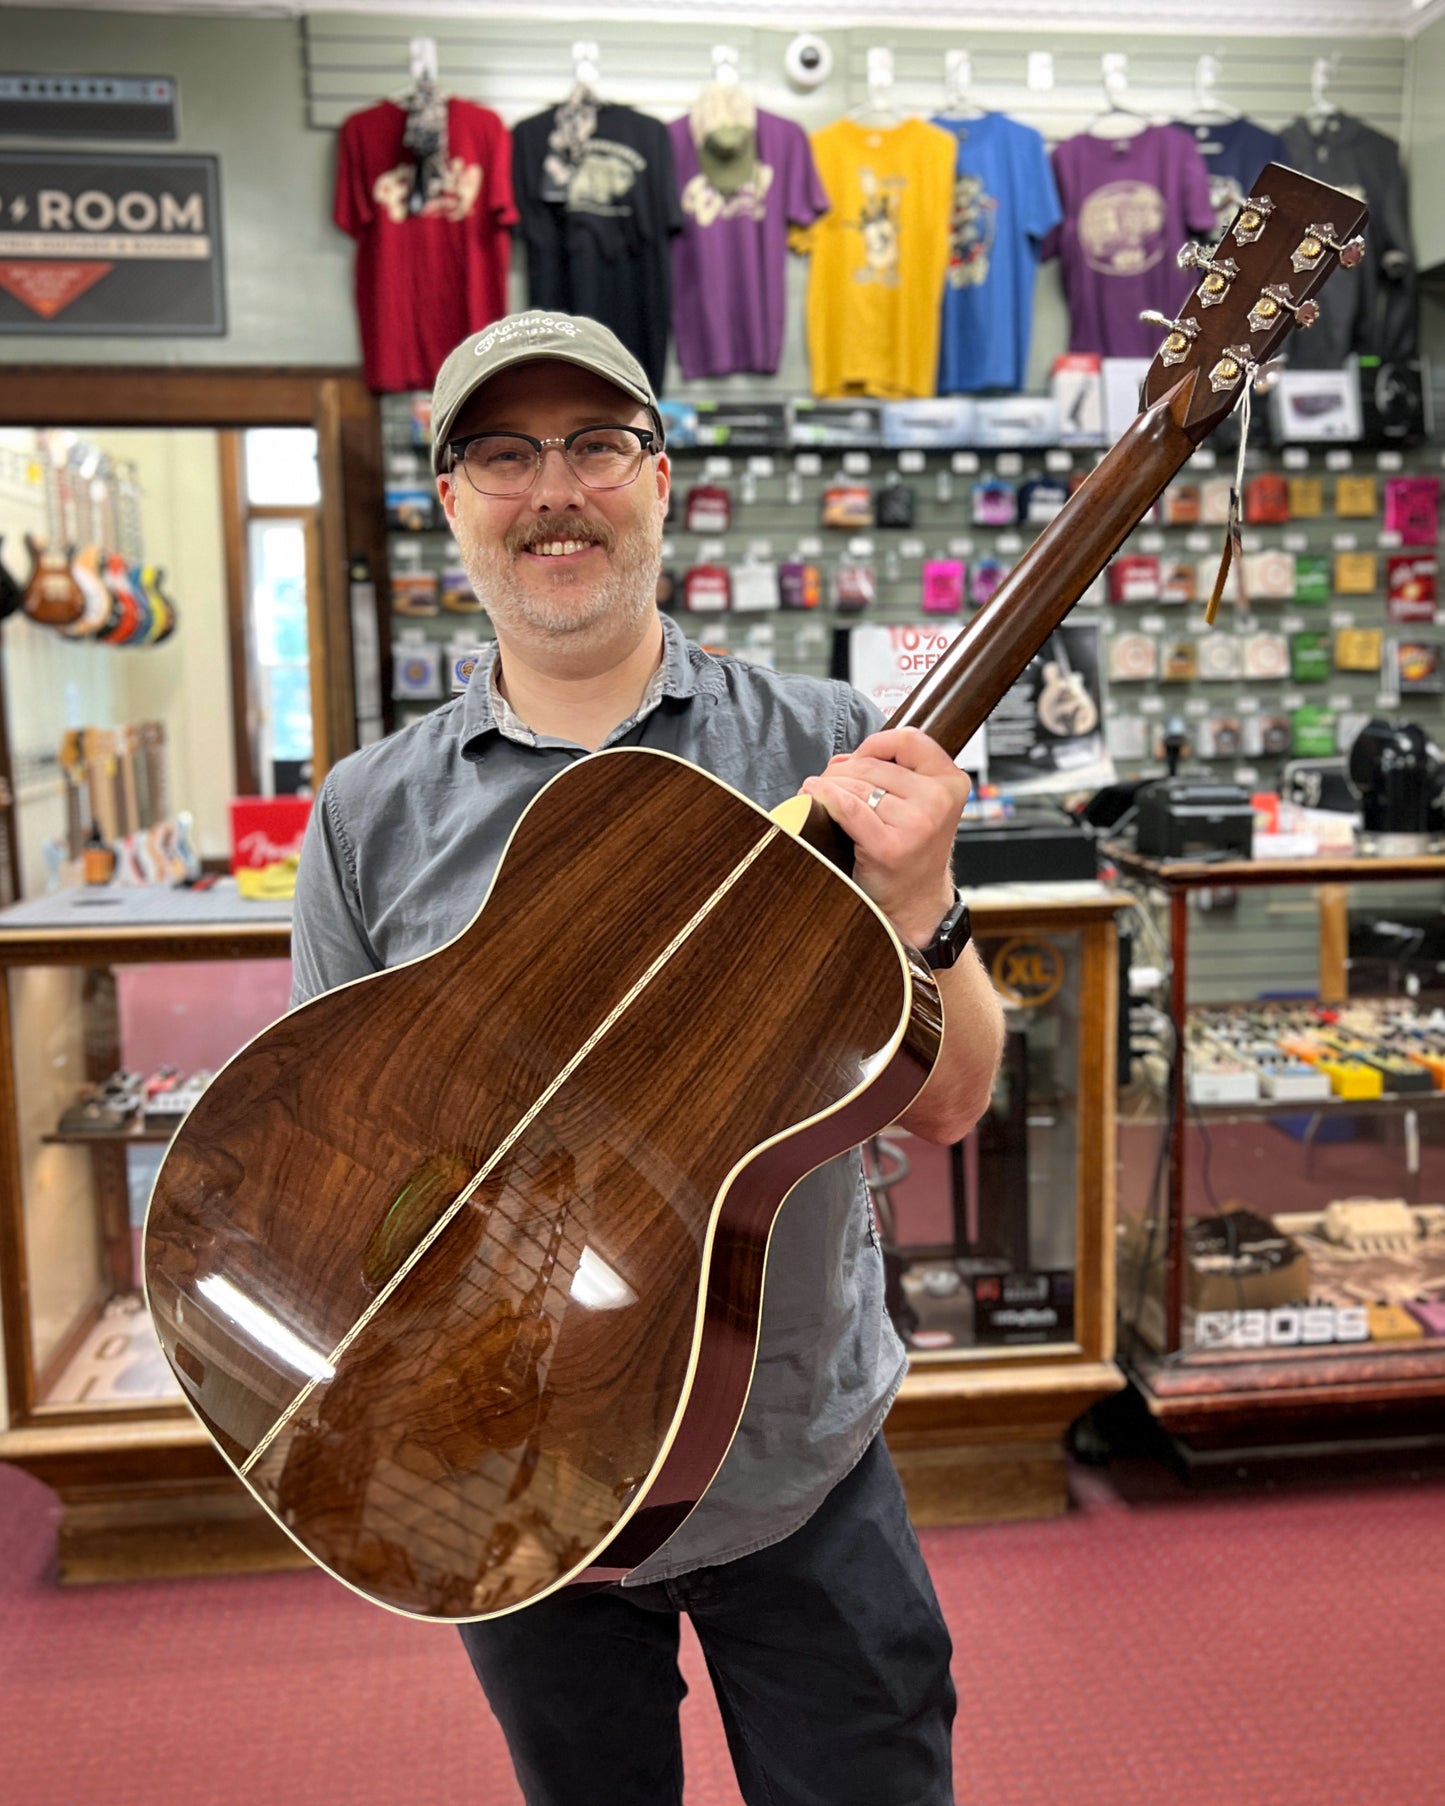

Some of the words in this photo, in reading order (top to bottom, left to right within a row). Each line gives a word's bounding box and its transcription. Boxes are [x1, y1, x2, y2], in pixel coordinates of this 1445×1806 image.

[38, 190, 204, 232] ROOM
[888, 624, 948, 652] 10%
[1007, 955, 1054, 985] XL
[1234, 1306, 1369, 1348] BOSS
